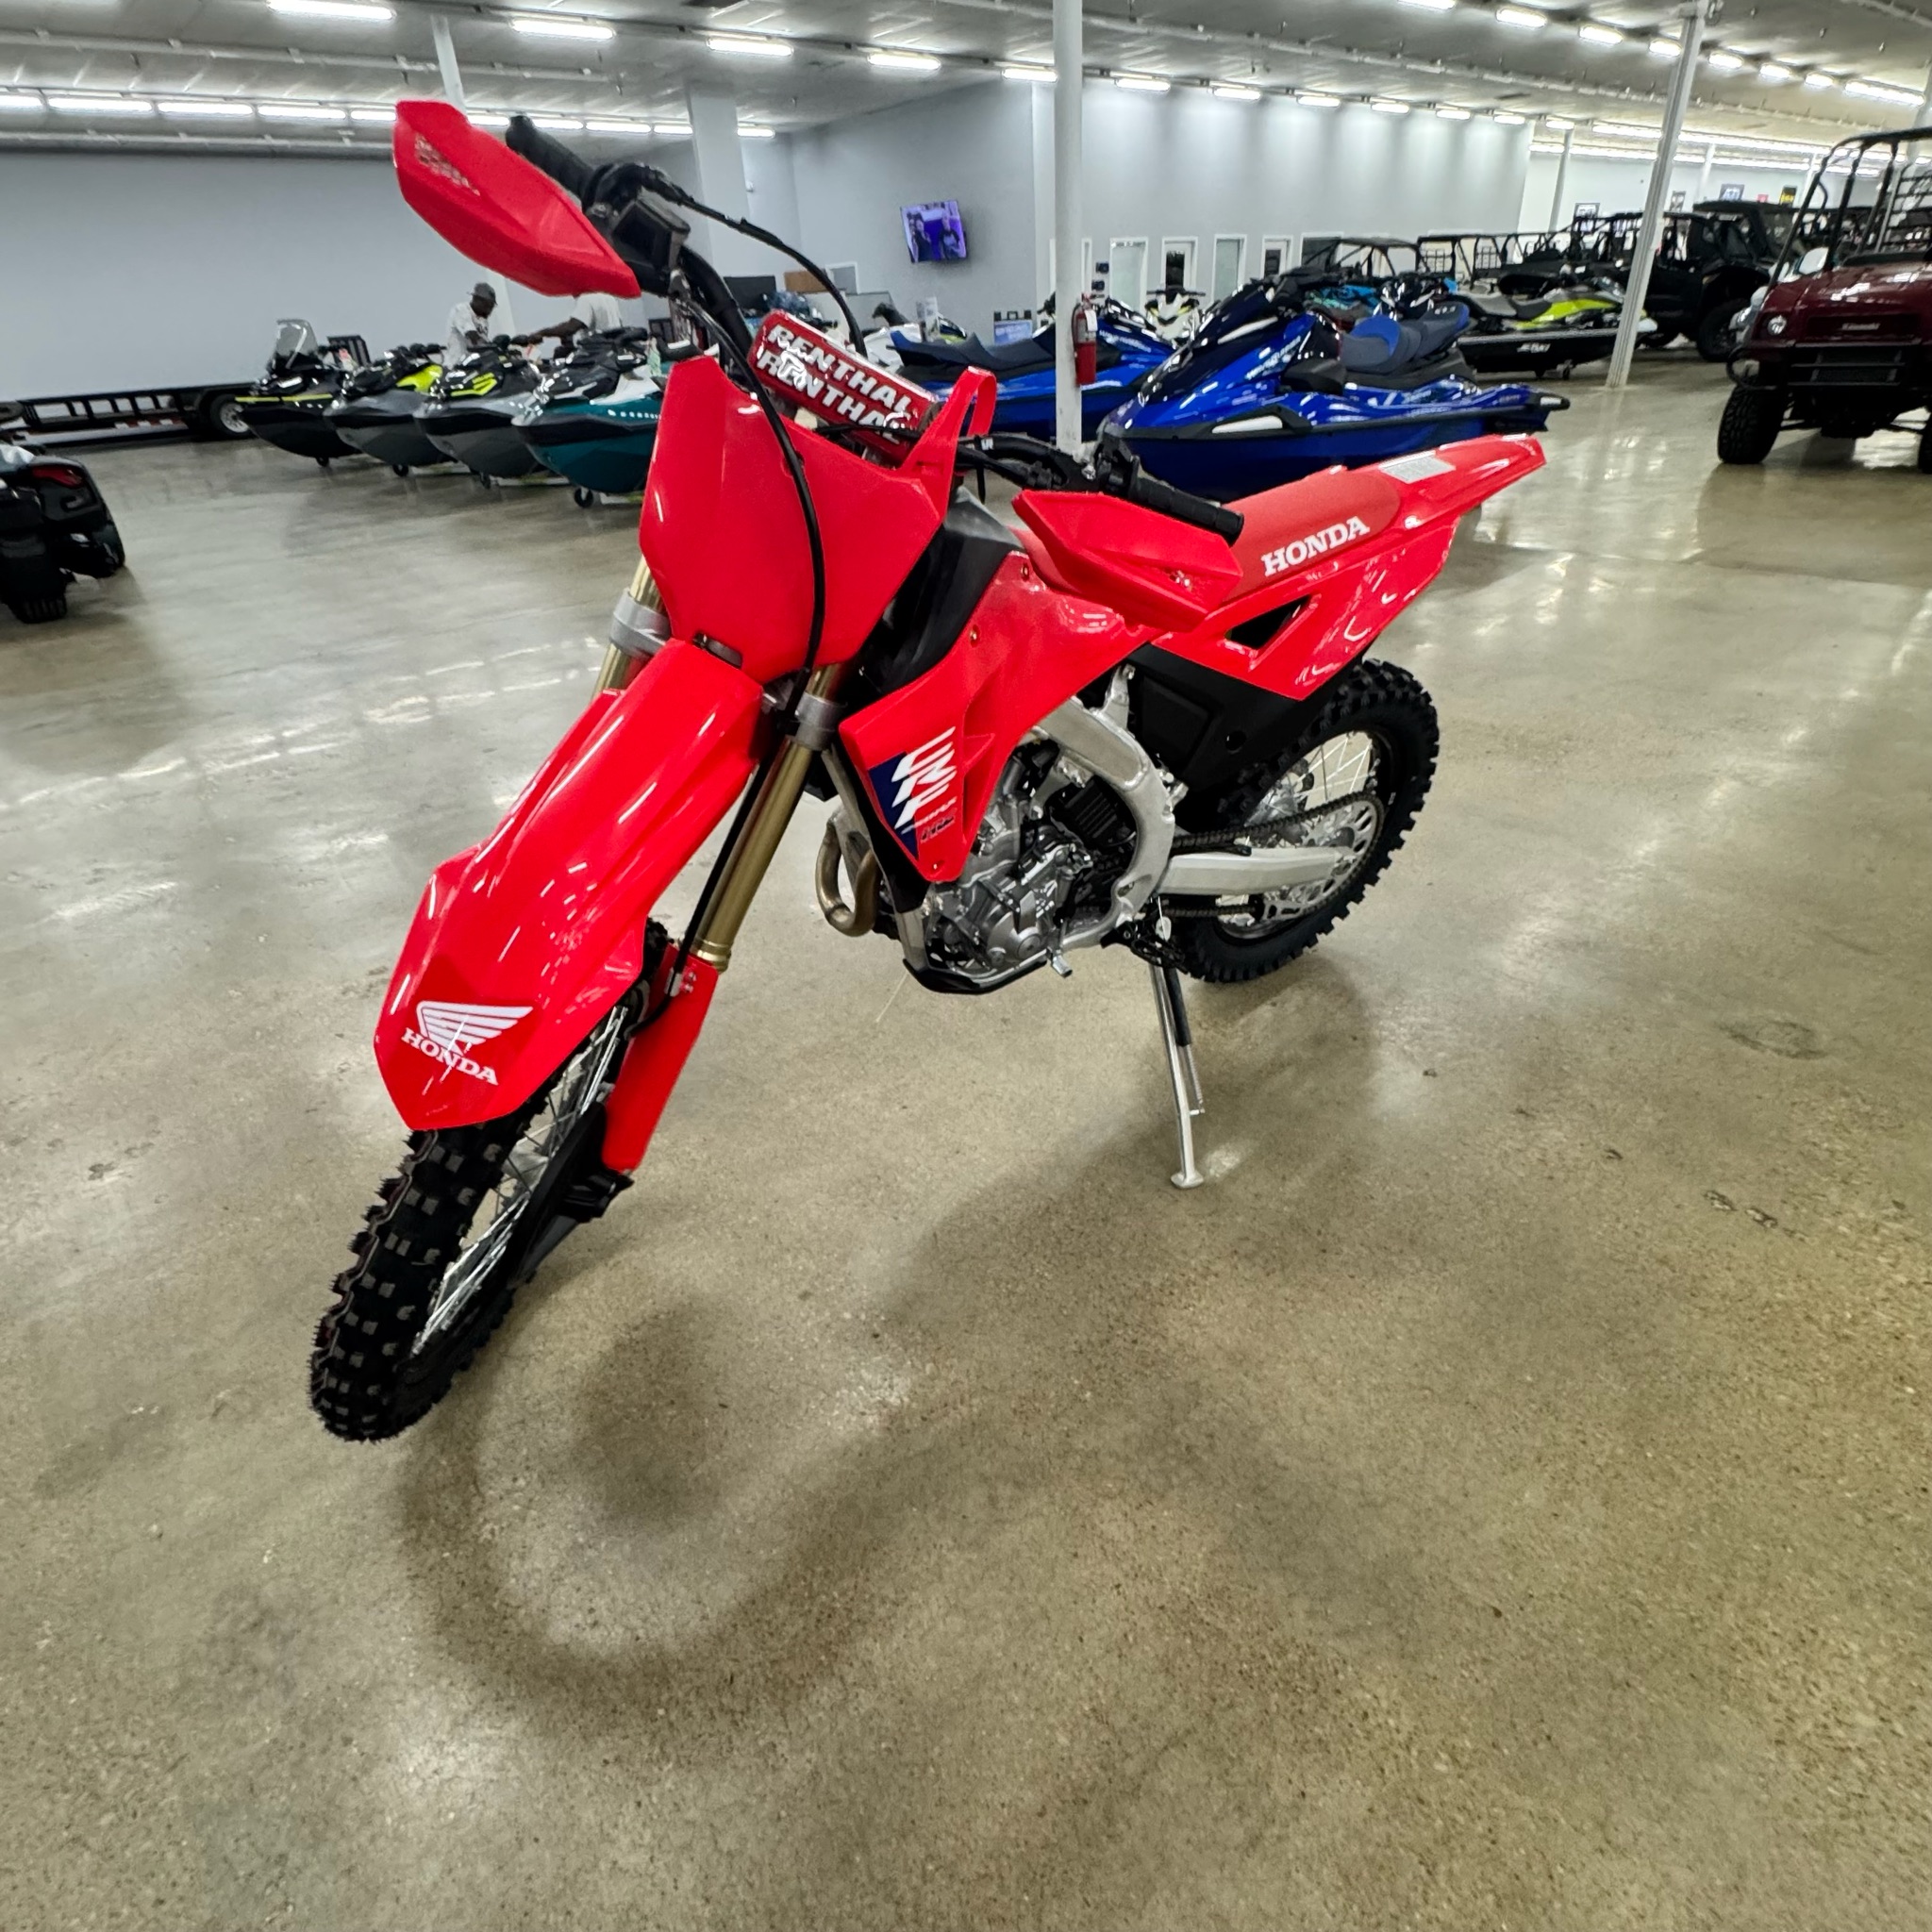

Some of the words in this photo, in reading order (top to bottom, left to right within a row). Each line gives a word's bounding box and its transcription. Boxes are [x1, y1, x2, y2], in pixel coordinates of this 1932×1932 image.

[767, 325, 911, 420] RENTHAL
[1260, 516, 1370, 577] HONDA
[401, 1027, 499, 1086] HONDA
